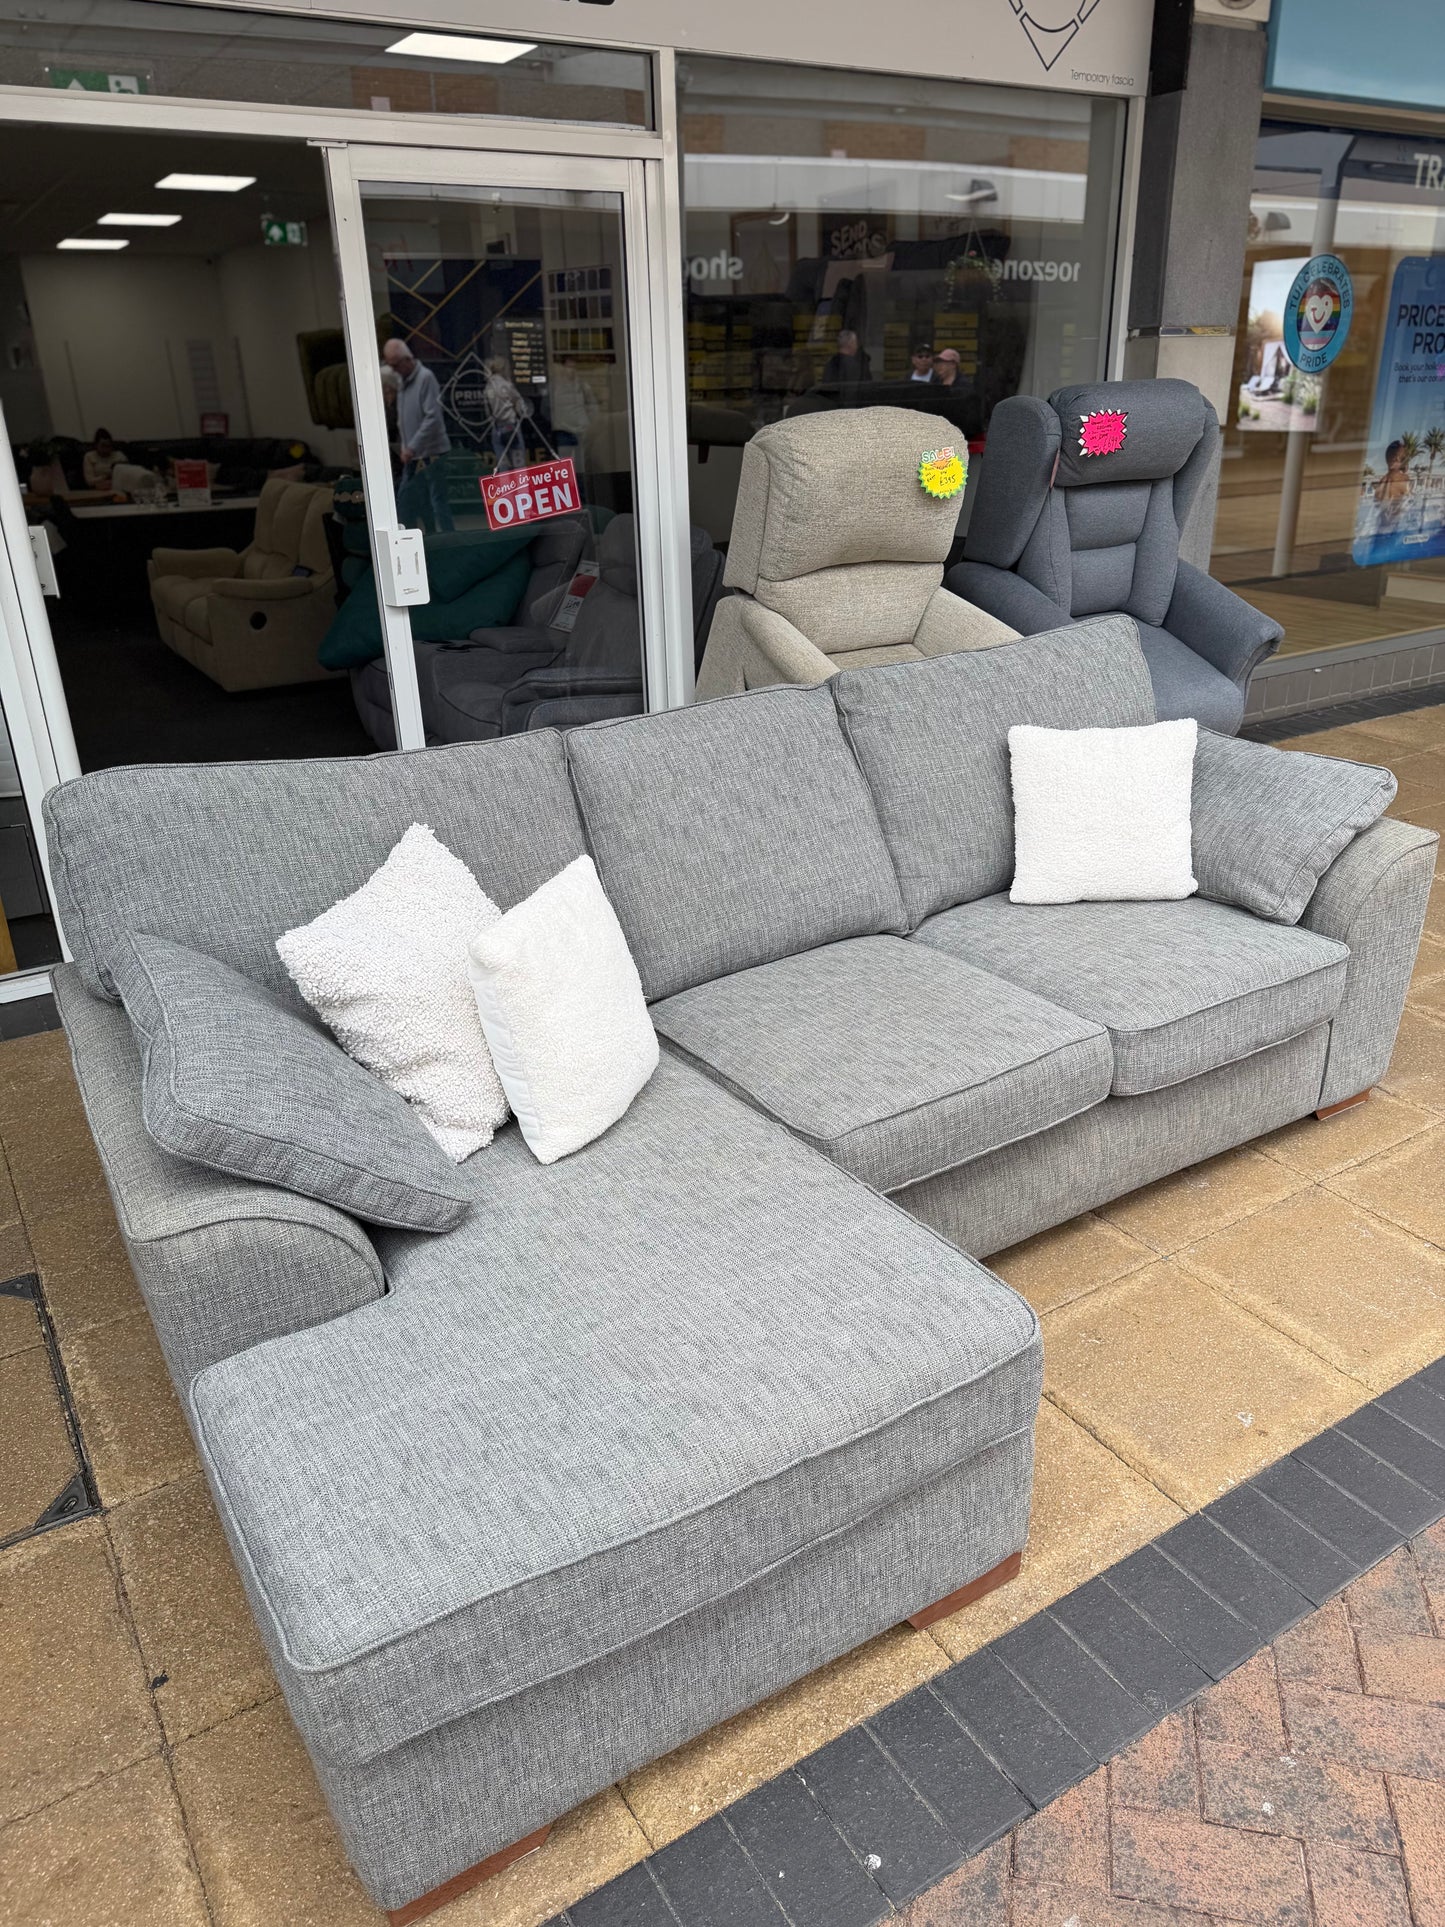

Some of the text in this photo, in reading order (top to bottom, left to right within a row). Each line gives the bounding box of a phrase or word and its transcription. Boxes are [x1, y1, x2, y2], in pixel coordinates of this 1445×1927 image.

[1071, 69, 1134, 87] Temporary fascia
[1413, 152, 1445, 191] TR
[1289, 262, 1351, 310] TUI CELEBRATES
[1397, 304, 1445, 327] PRICE
[1300, 352, 1328, 367] PRIDE
[922, 446, 955, 463] SALE!
[487, 467, 569, 499] Come in we're
[493, 482, 573, 524] OPEN
